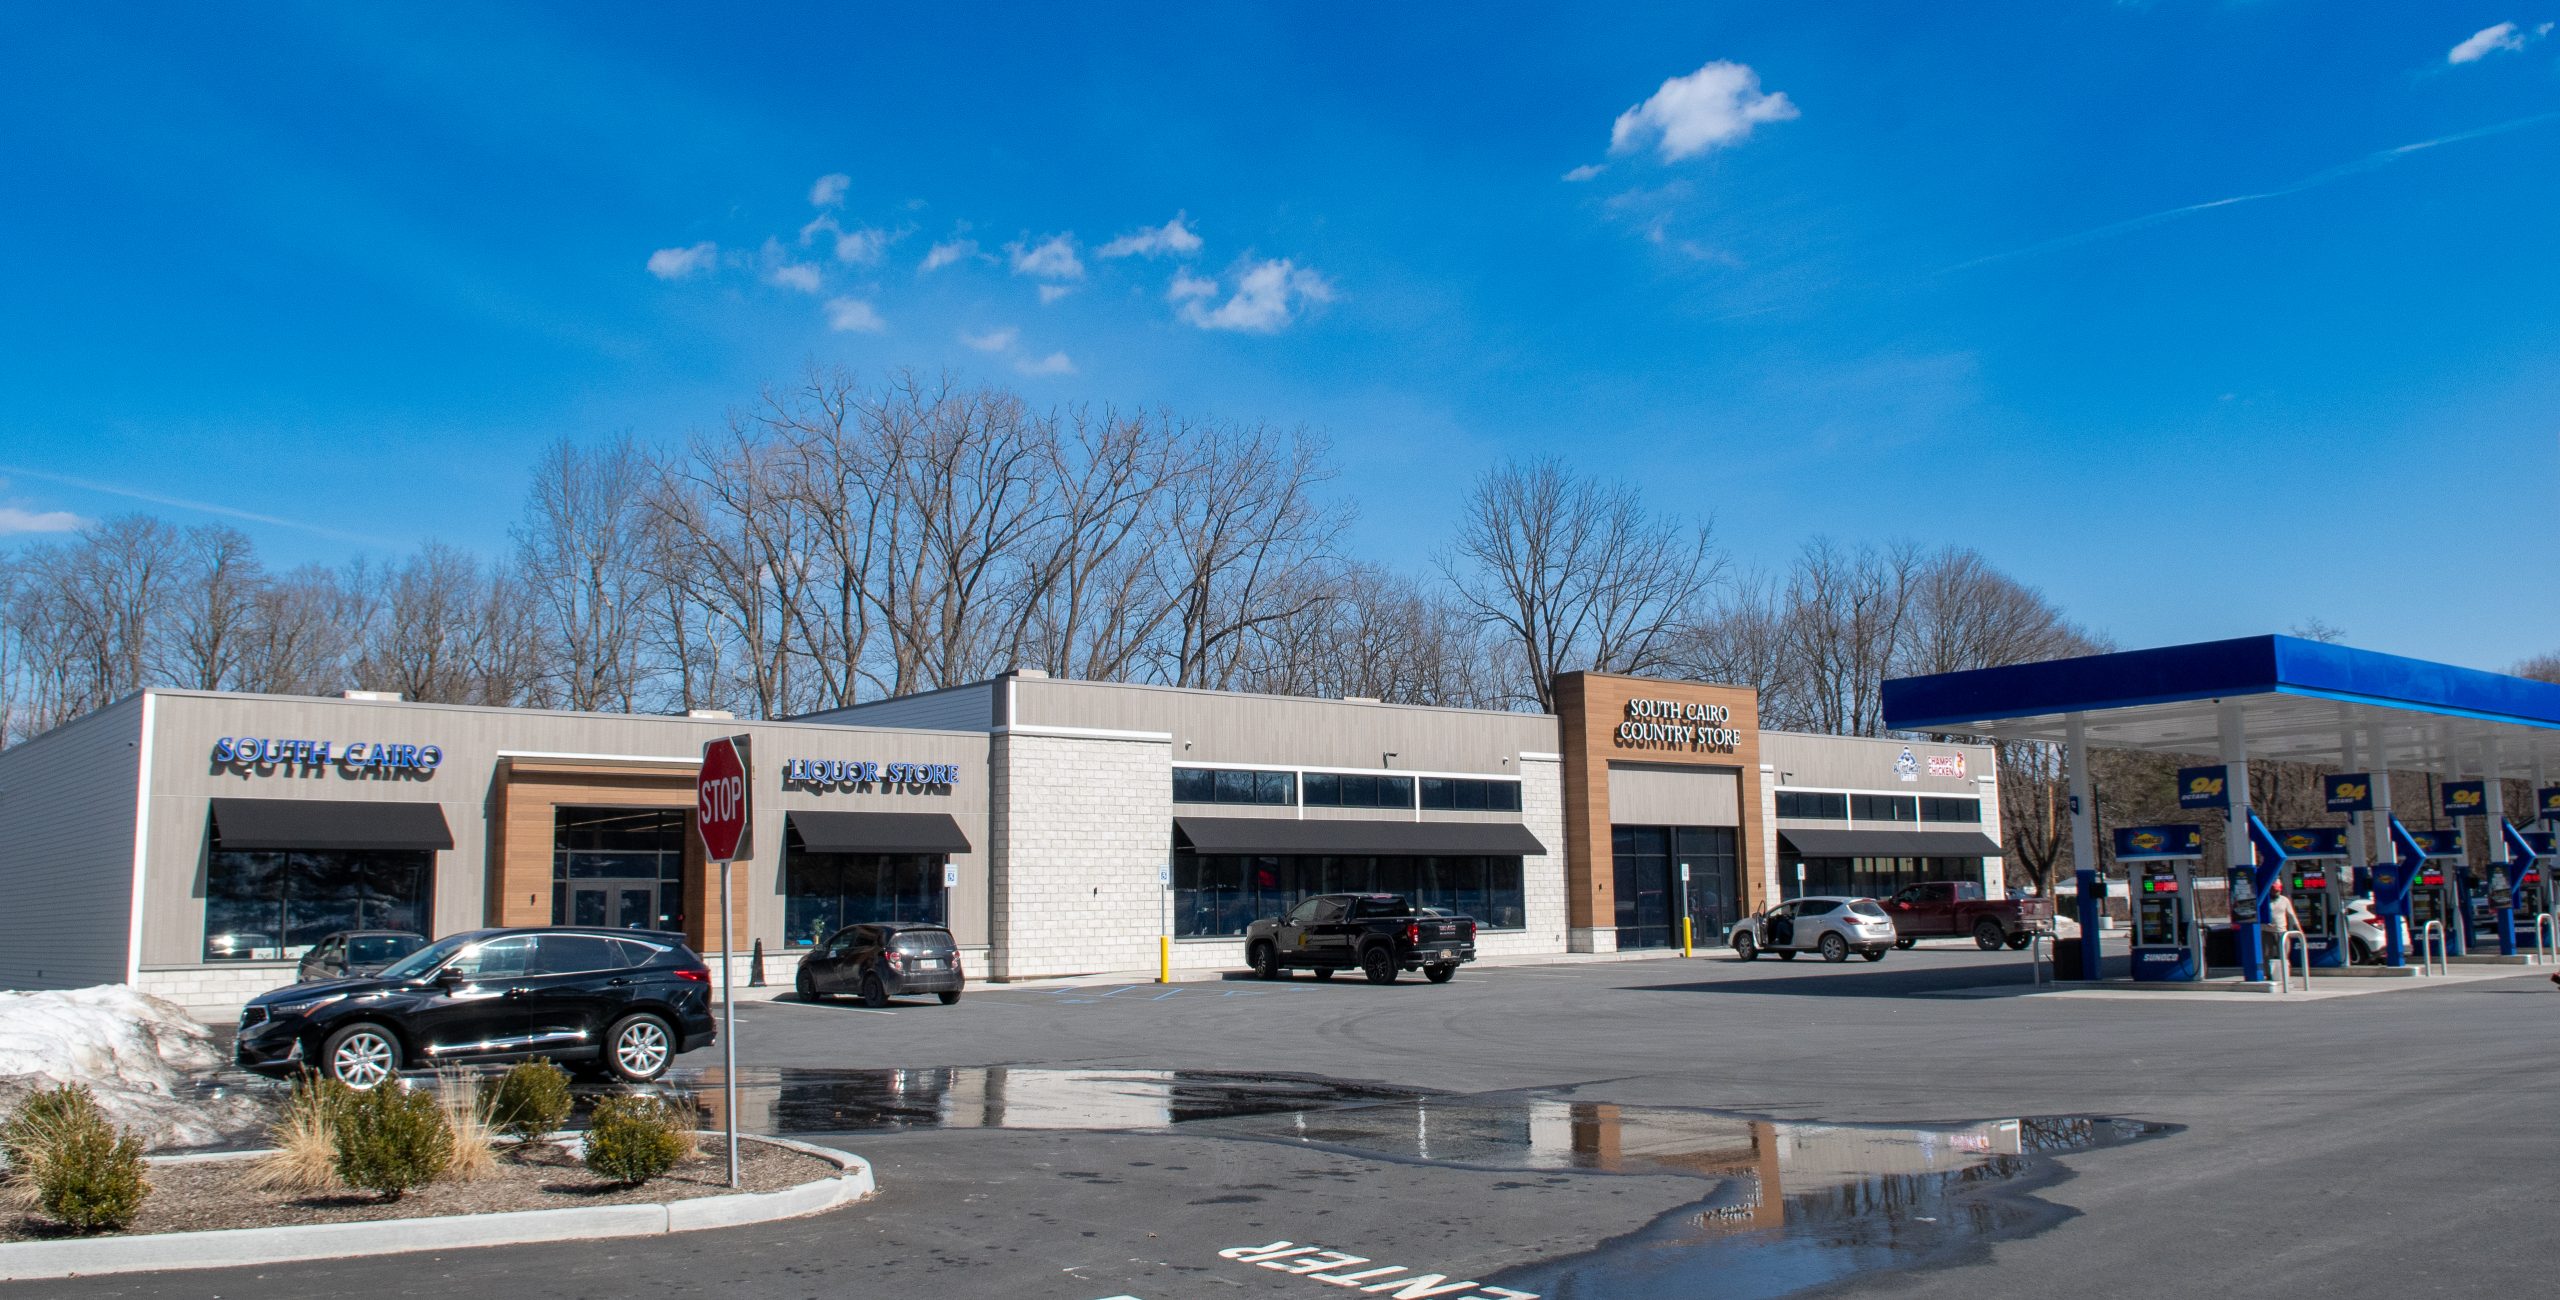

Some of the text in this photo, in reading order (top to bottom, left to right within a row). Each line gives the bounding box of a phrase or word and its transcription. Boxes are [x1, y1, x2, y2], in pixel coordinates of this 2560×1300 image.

[1630, 698, 1729, 722] SOUTH CAIRO
[1621, 721, 1741, 746] COUNTRY STORE
[217, 736, 443, 769] SOUTH CAIRO
[1928, 756, 1952, 766] CHAMPS
[789, 758, 960, 784] LIQUOR STORE
[1928, 766, 1954, 776] CHICKEN
[2191, 777, 2223, 795] 94
[2336, 783, 2366, 800] 94
[701, 775, 742, 825] STOP
[2453, 789, 2481, 806] 94
[2143, 953, 2179, 961] SUNOCO
